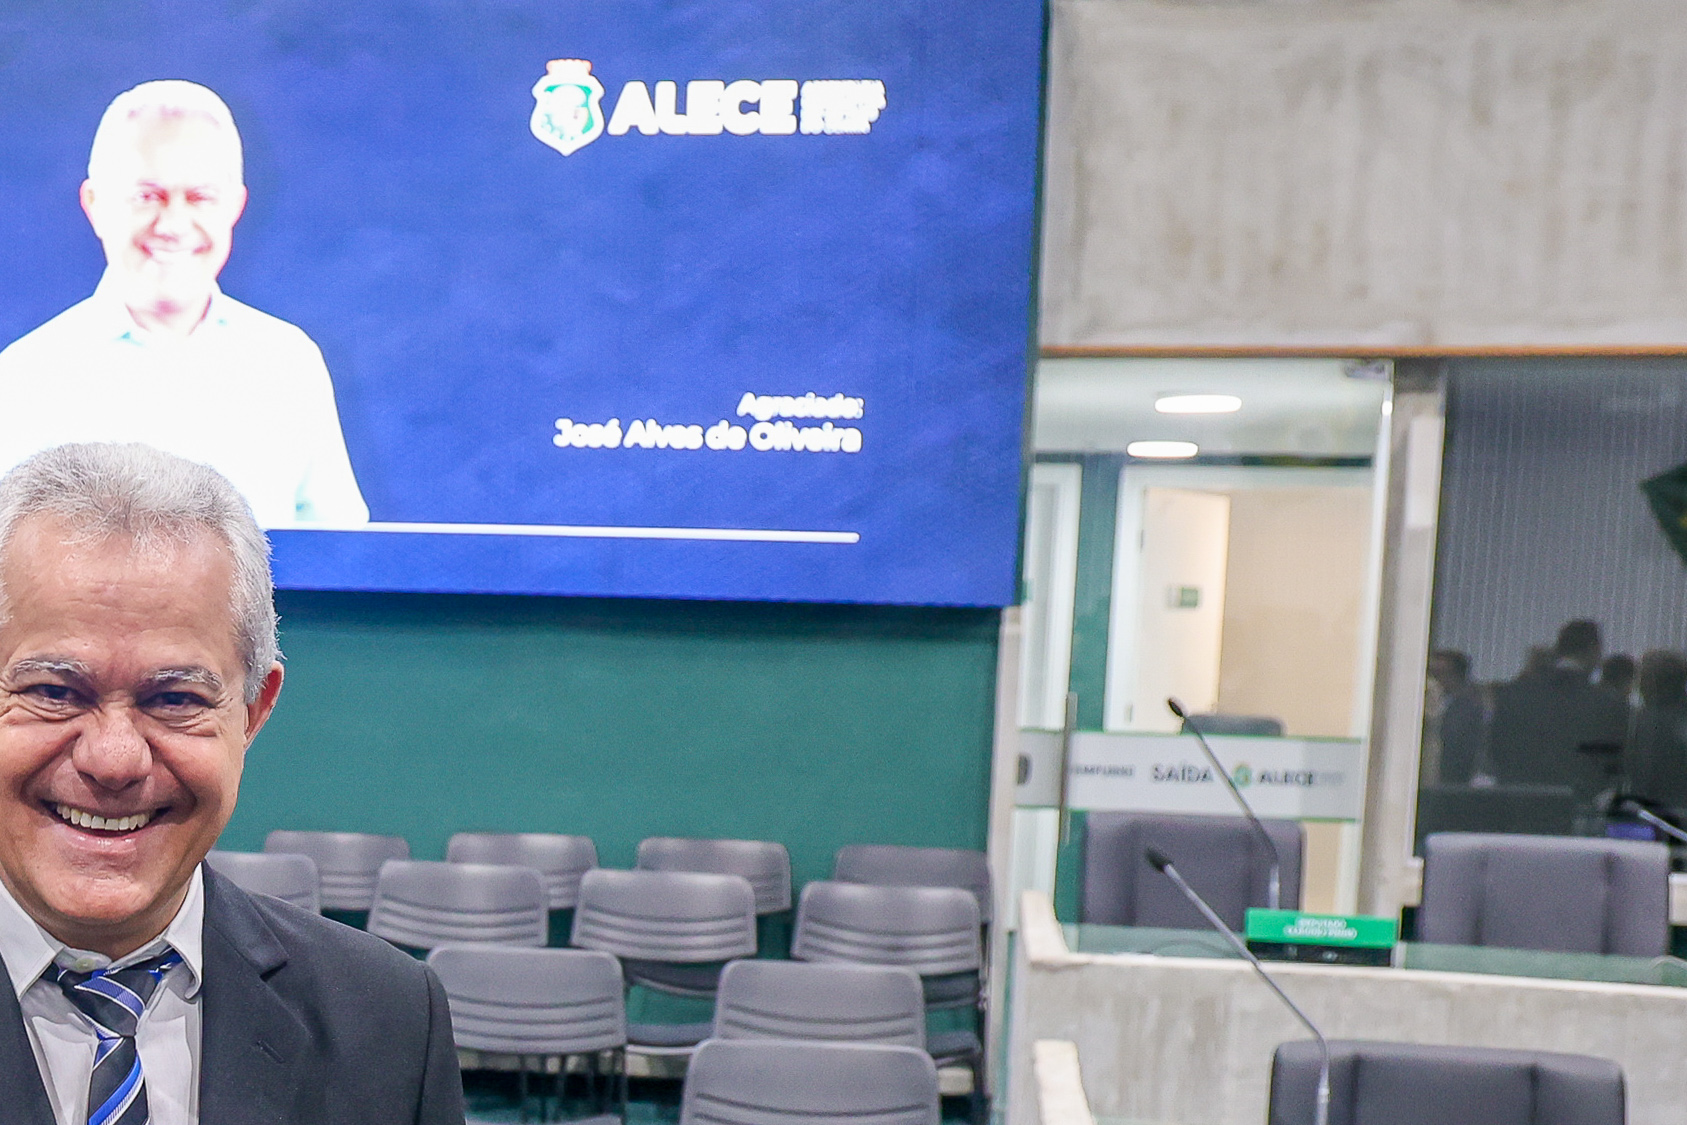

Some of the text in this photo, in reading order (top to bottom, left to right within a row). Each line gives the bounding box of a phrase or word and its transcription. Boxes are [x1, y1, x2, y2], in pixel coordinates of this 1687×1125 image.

[607, 79, 799, 135] ALECE
[705, 420, 748, 450] de
[748, 421, 863, 453] Oliveira
